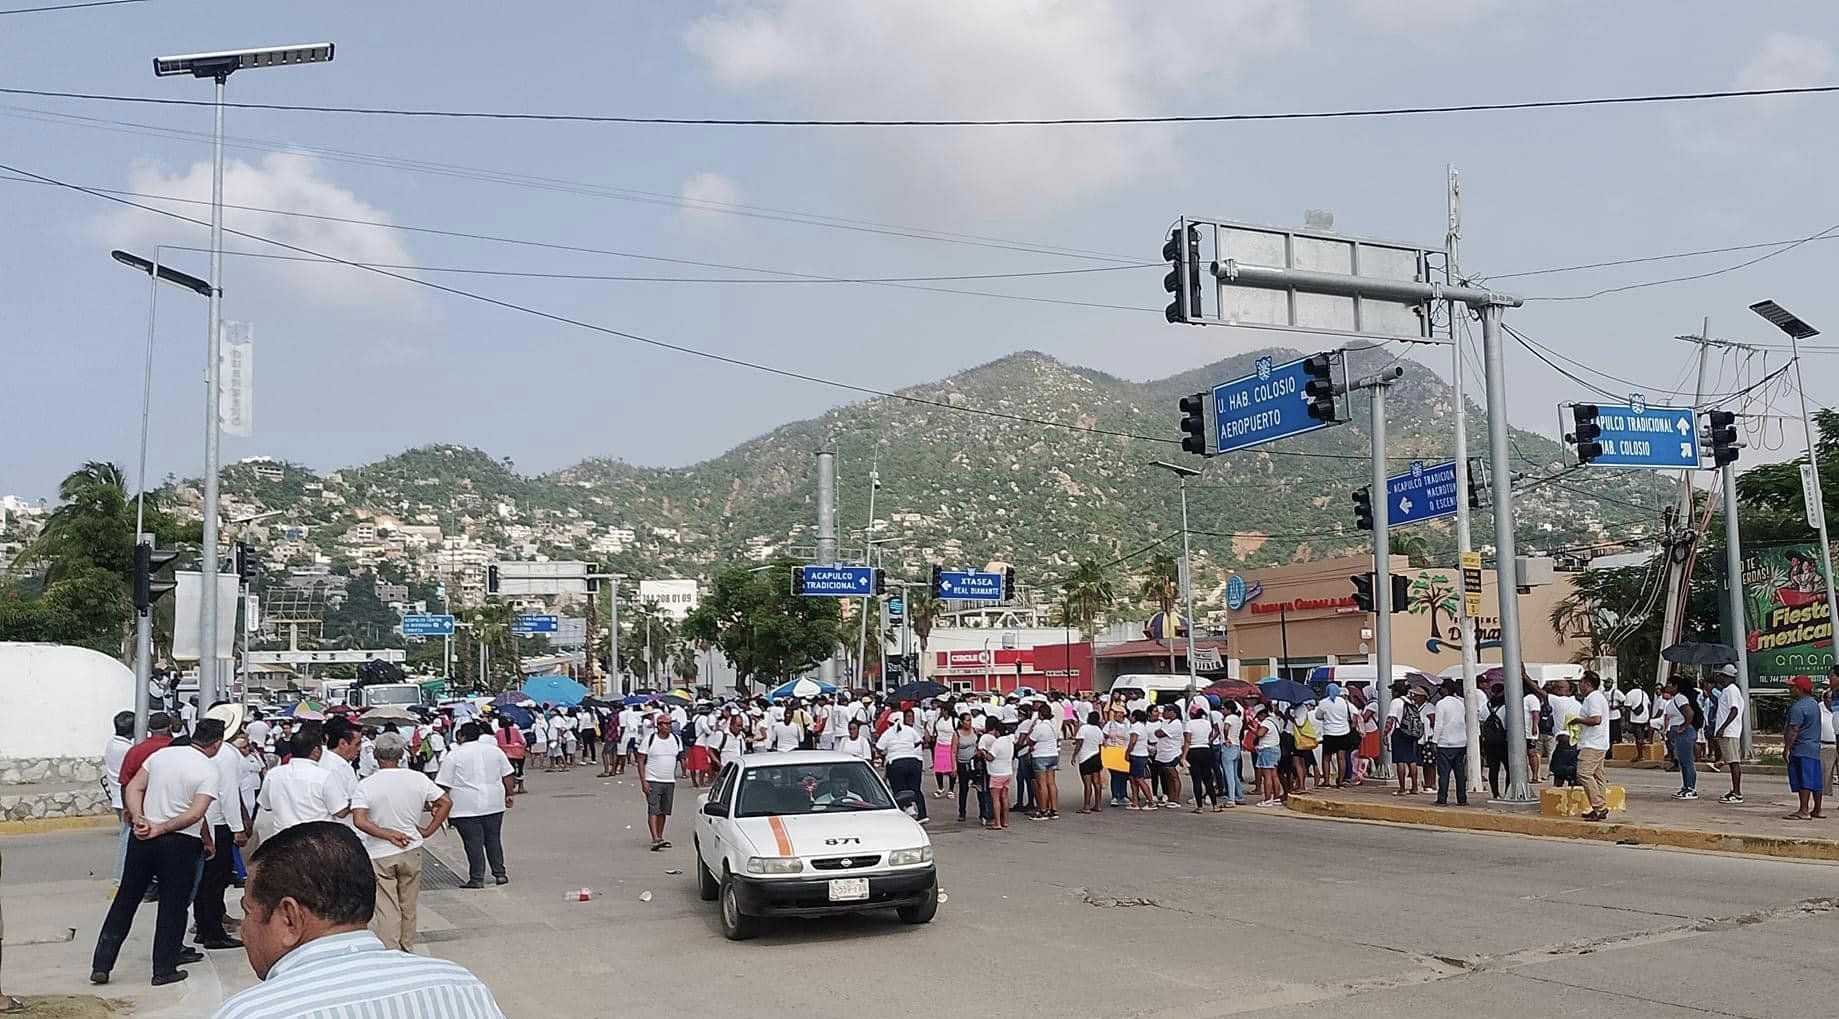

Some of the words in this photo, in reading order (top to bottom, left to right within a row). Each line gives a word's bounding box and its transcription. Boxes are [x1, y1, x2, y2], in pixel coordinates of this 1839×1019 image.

[1217, 398, 1228, 414] U.
[1229, 391, 1252, 411] HAB.
[1254, 376, 1296, 402] COLOSIO
[1220, 408, 1281, 440] AEROPUERTO
[1590, 415, 1625, 432] APULCO
[1627, 416, 1674, 433] TRADICIONAL
[1619, 441, 1650, 456] COLOSIO
[1423, 470, 1455, 485] TRADICION
[811, 572, 853, 580] ACAPULCO
[960, 577, 993, 586] XTASEA
[1742, 566, 1769, 585] ERDAS!
[806, 581, 867, 590] TRADICIONAL
[1757, 622, 1832, 650] mexica
